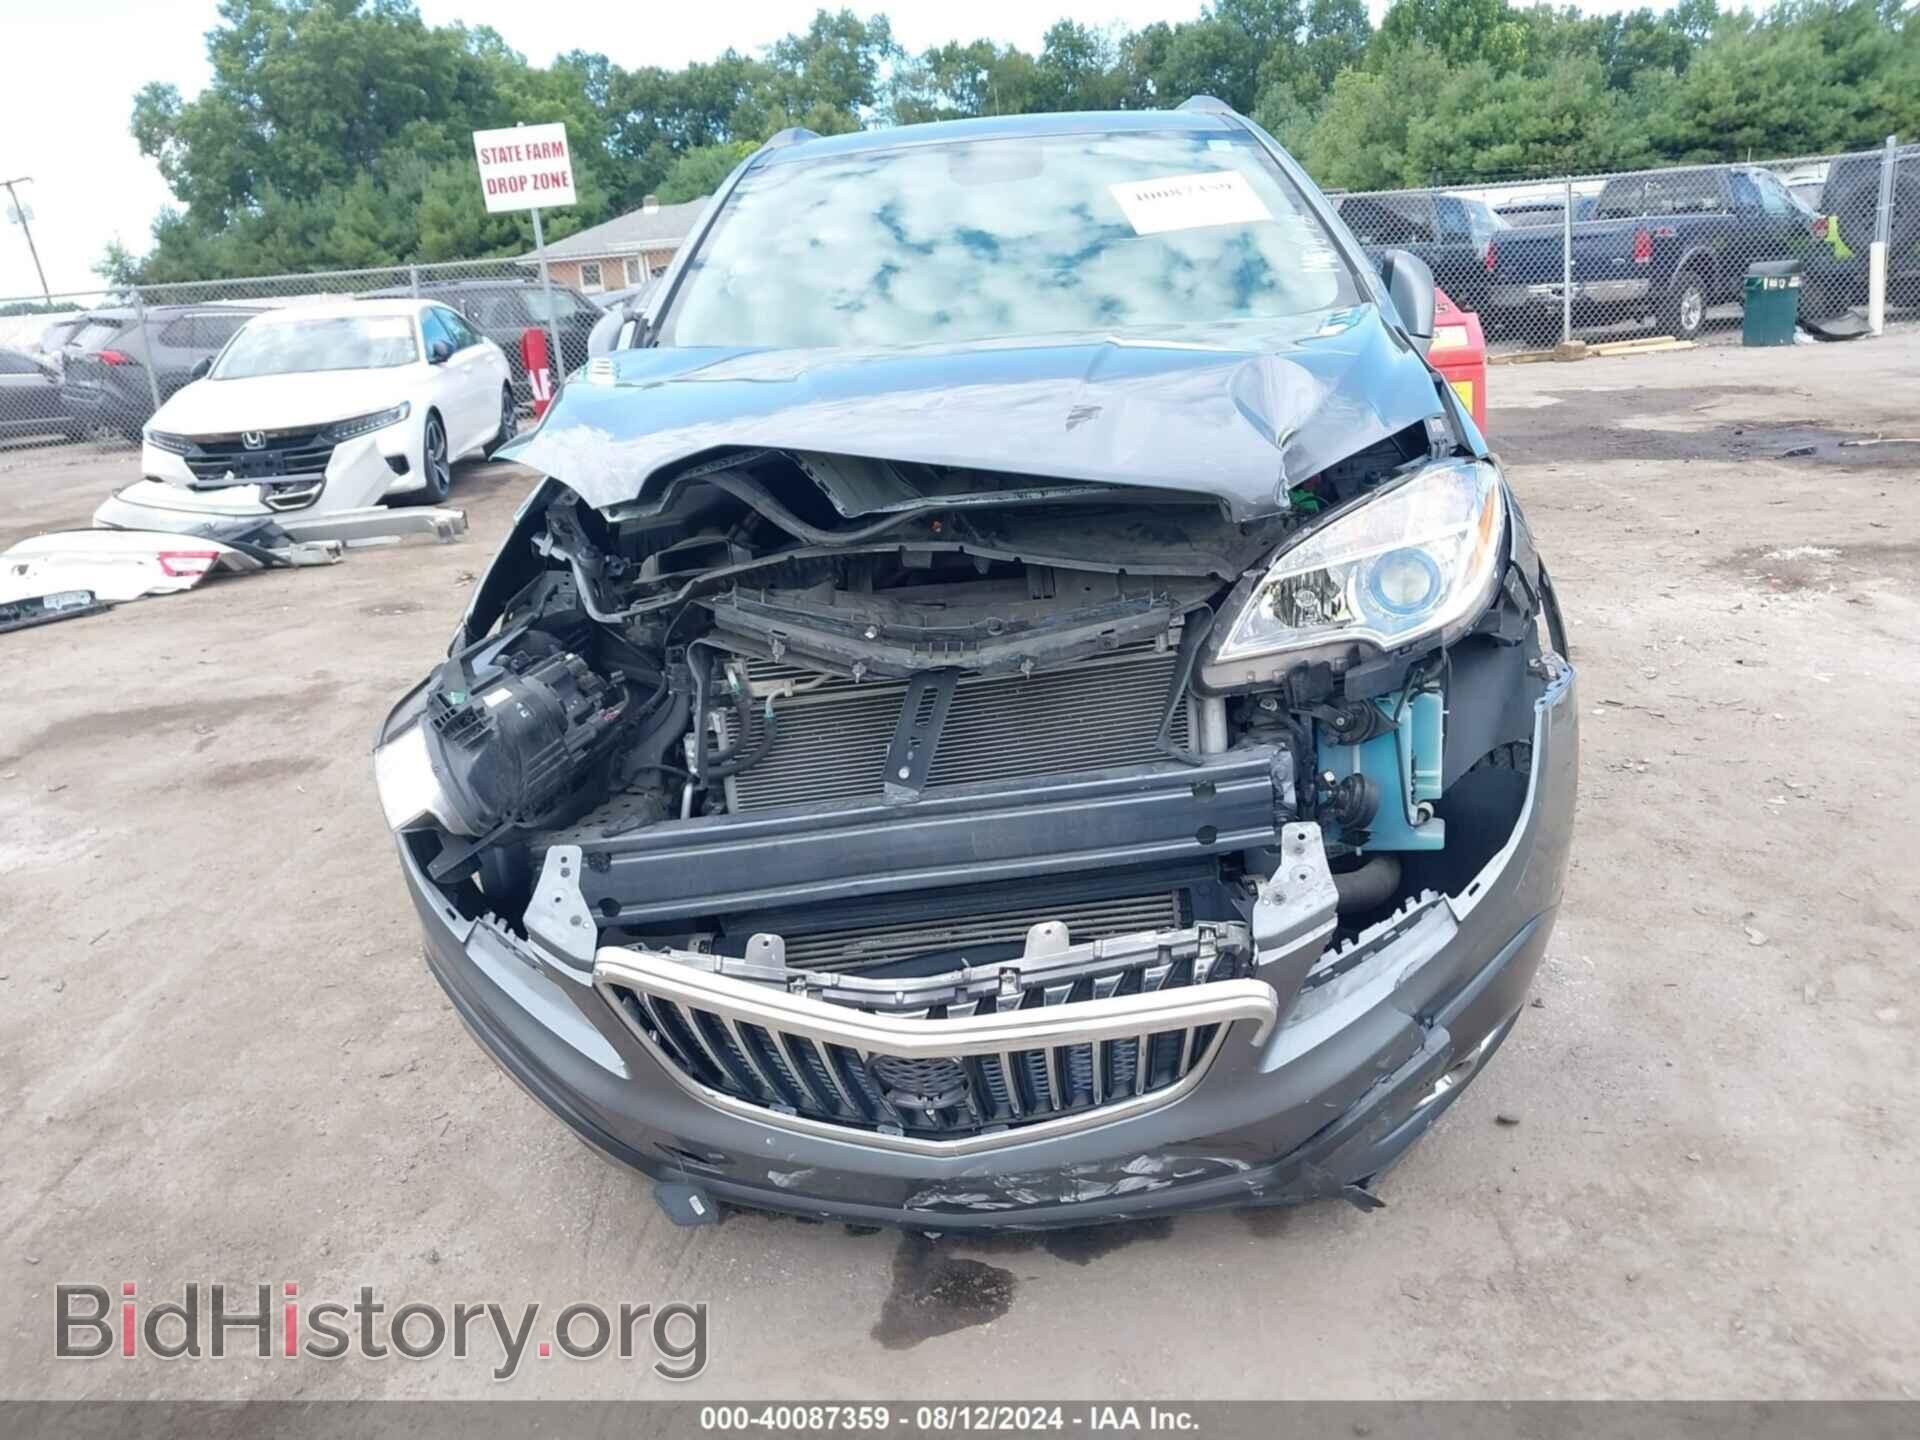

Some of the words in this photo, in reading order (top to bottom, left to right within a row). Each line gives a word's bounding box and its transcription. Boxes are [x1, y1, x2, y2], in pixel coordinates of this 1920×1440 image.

[480, 145, 523, 165] STATE
[525, 141, 564, 160] FARM
[486, 175, 528, 195] DROP
[532, 171, 570, 190] ZONE
